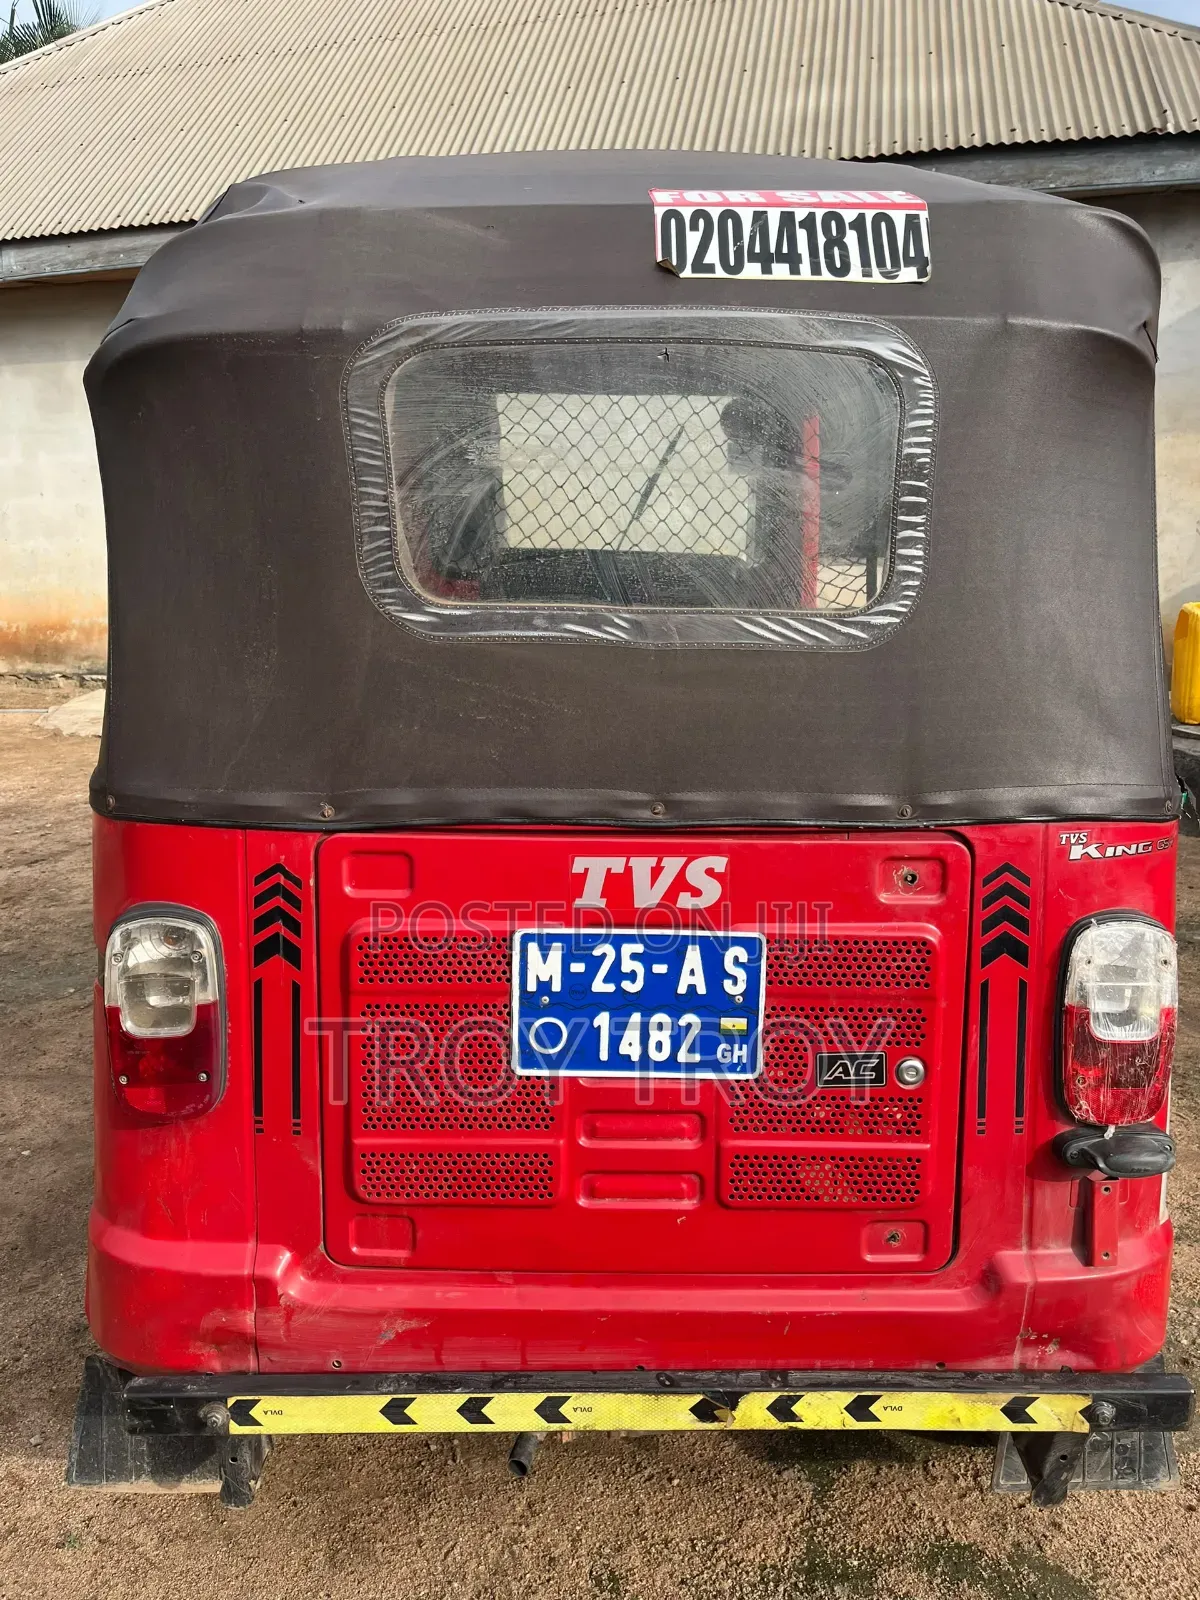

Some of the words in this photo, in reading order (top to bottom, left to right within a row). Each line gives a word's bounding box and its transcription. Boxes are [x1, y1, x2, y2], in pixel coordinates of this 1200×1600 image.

[652, 190, 767, 204] FOR
[775, 190, 924, 204] SALE
[660, 208, 930, 280] 0204418104
[1059, 832, 1088, 845] TVS
[1068, 841, 1152, 861] KING
[571, 856, 728, 909] TVS
[593, 1011, 702, 1063] 1482
[716, 1043, 748, 1065] GH
[823, 1059, 880, 1080] AC
